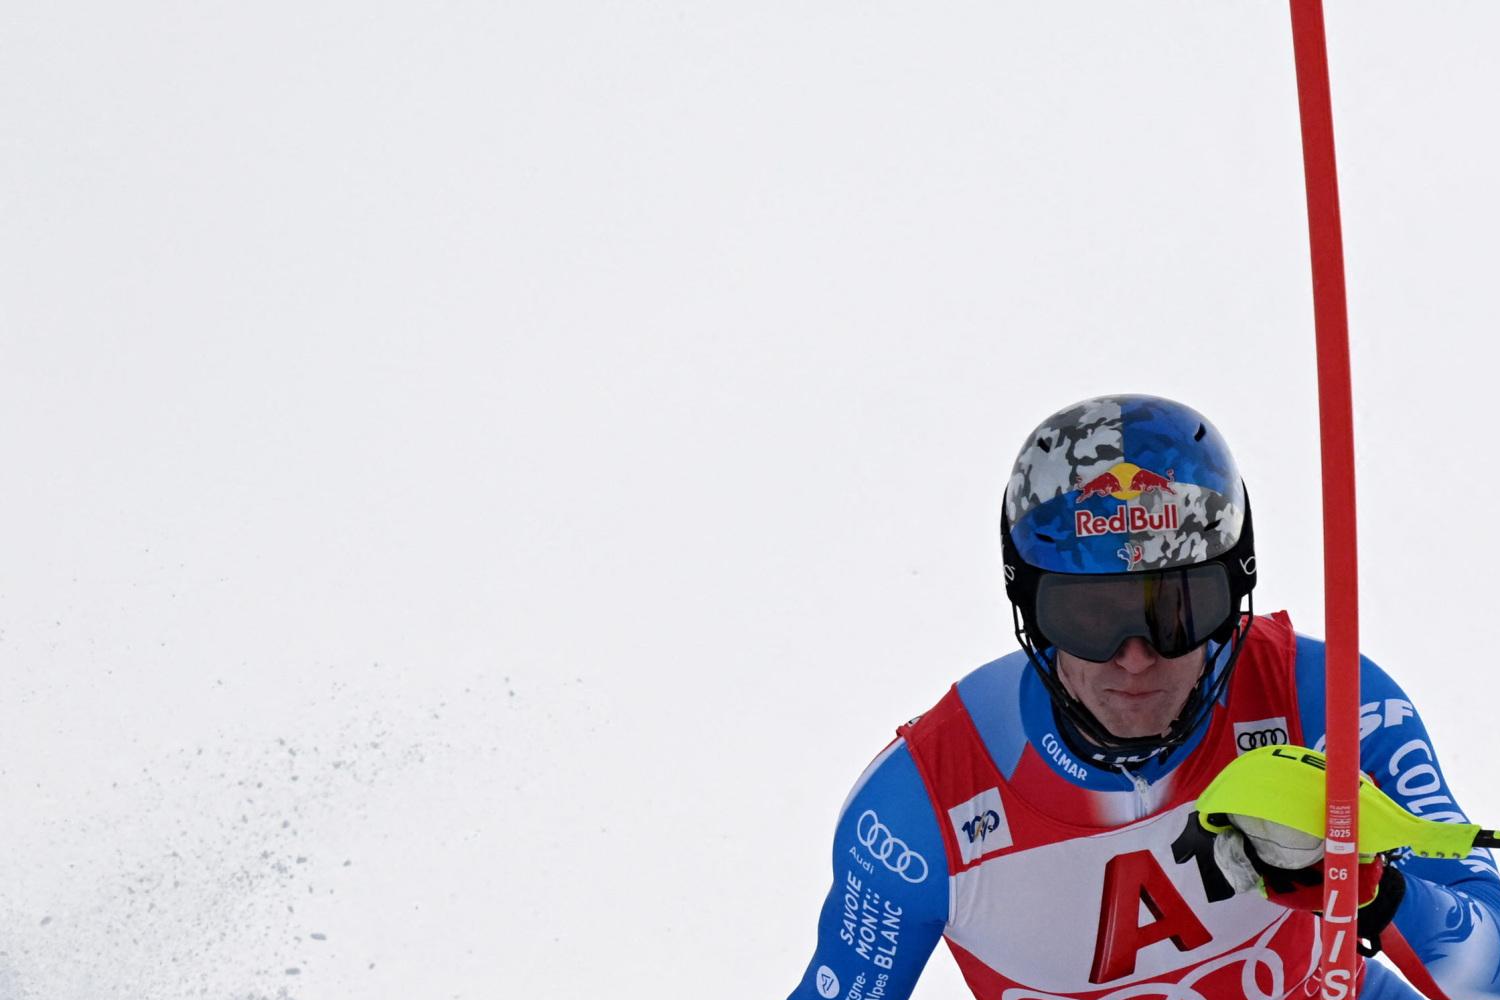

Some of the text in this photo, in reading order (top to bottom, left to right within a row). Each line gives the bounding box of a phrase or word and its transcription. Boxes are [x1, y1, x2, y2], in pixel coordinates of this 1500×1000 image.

[1041, 733, 1087, 781] COLMAR
[1328, 828, 1351, 838] 2025
[849, 846, 875, 875] Audi
[1328, 867, 1348, 880] C6
[840, 870, 863, 946] SAVOIE
[873, 901, 903, 970] BLANC
